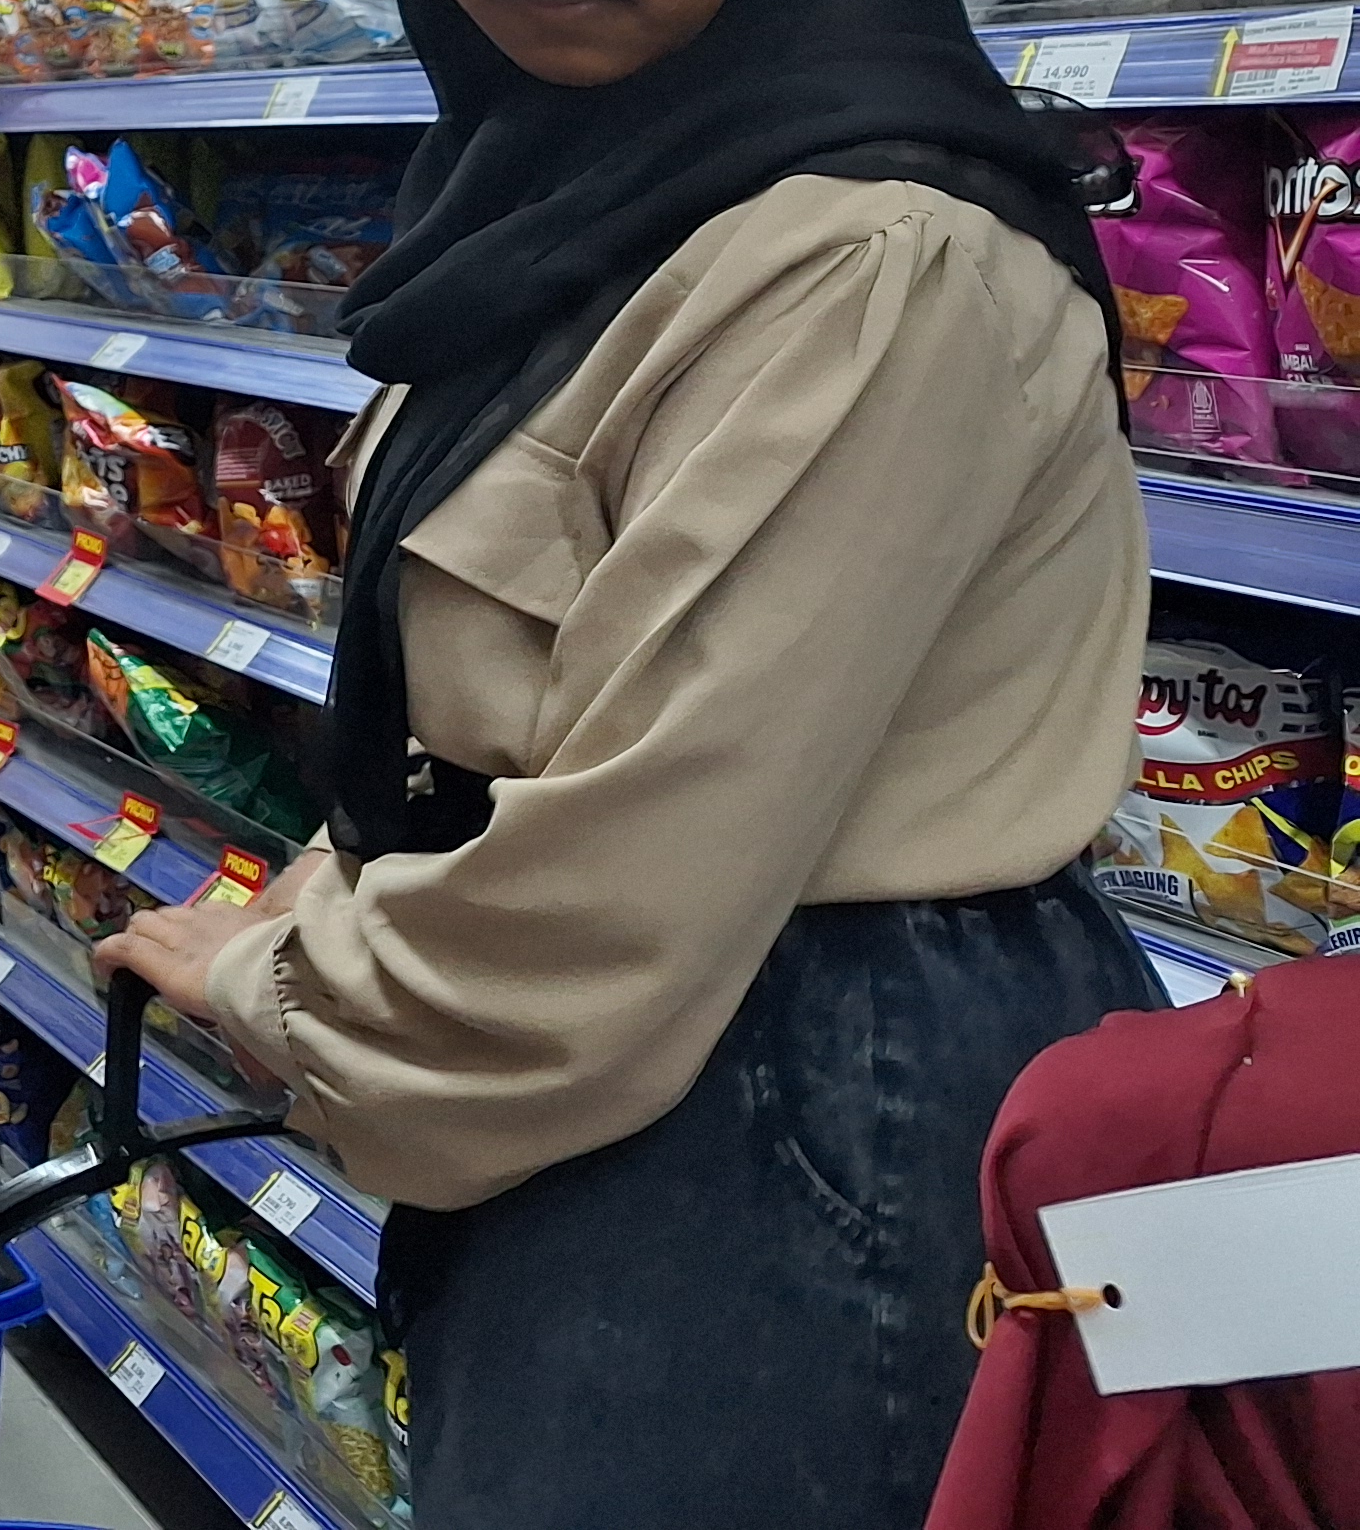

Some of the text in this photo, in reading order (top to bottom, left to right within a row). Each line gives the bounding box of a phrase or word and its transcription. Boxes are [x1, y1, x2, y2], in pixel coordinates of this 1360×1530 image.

[1043, 64, 1089, 80] 14,990
[1214, 750, 1300, 790] CHIPS
[124, 795, 156, 824] PROMO
[224, 850, 261, 882] PROMO
